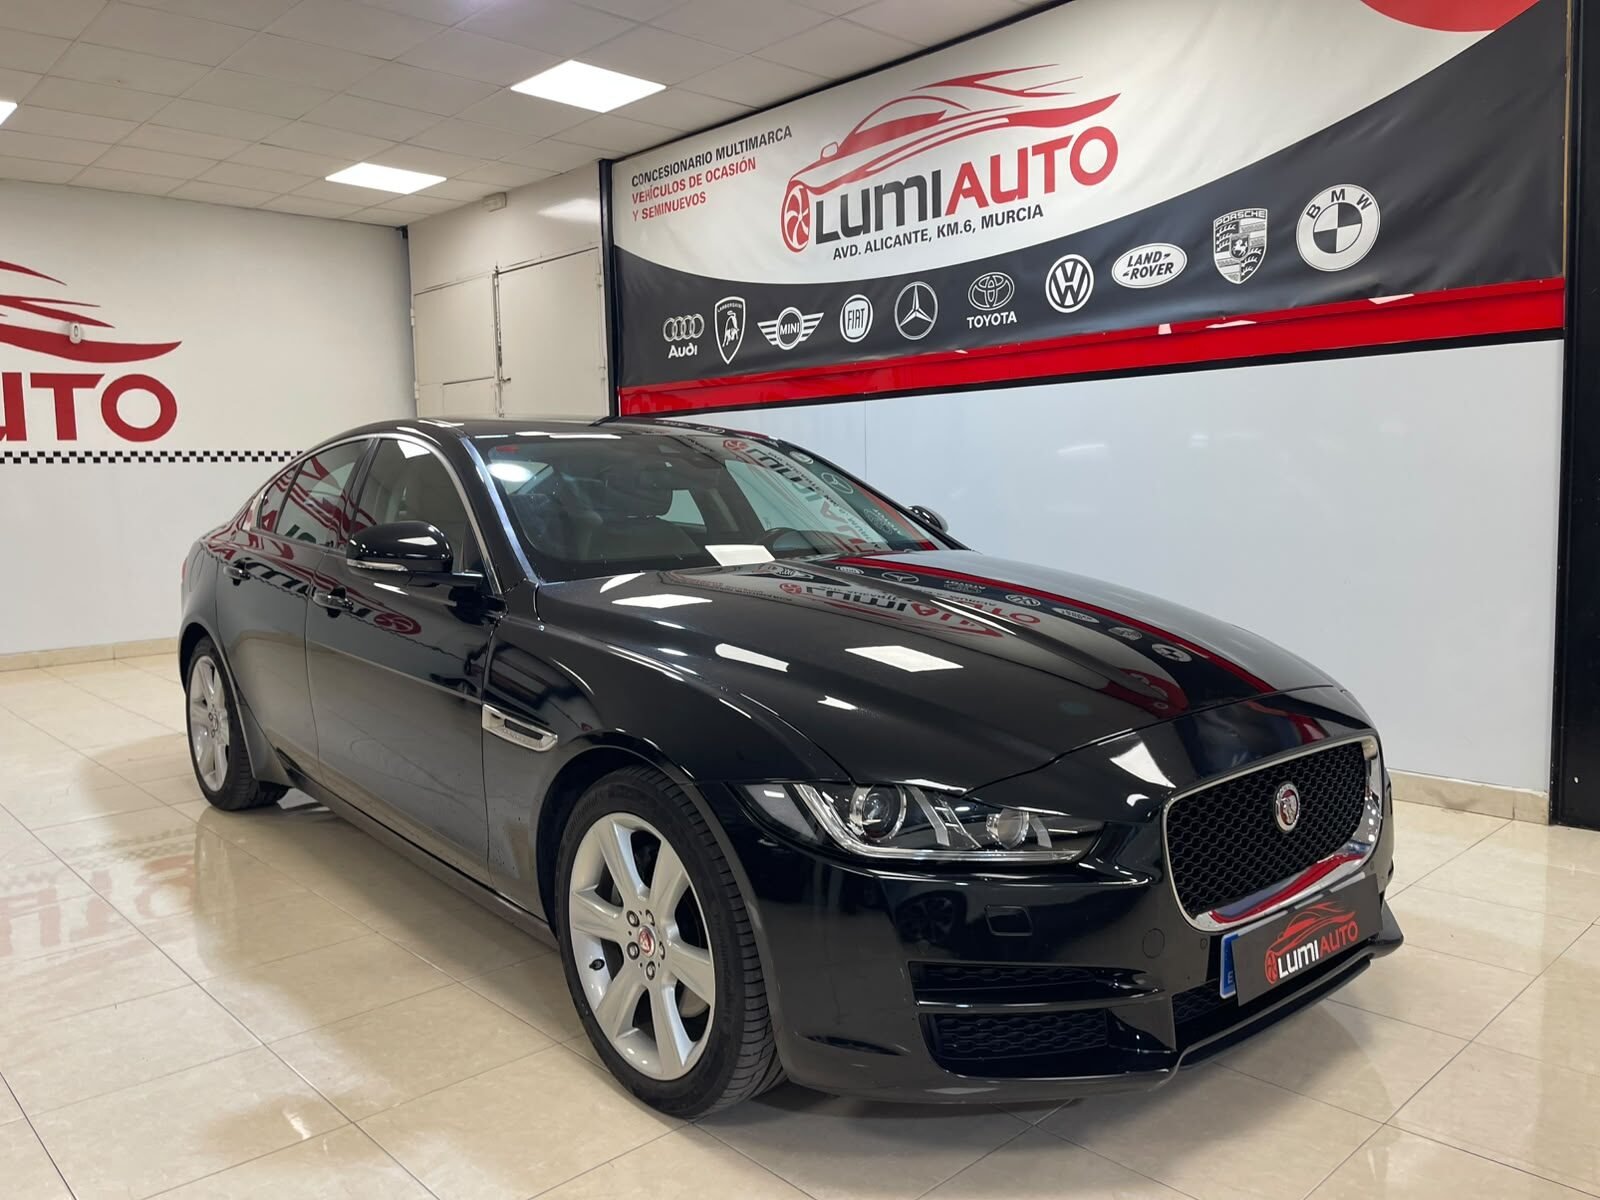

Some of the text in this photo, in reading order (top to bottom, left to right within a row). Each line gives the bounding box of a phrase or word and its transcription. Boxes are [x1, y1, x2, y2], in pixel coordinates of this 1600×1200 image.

[632, 125, 792, 187] CONCESIONARIO MULTIMARCA
[632, 156, 756, 204] VEHÍCULOS DE OCASIÓN
[632, 191, 706, 222] Y SEMINUEVOS
[1306, 188, 1373, 220] BMW
[1215, 209, 1266, 228] PORSCHE
[833, 204, 1044, 260] AVD. ALICANTE, KM.6, MURCIA
[779, 322, 800, 335] MINI
[847, 308, 865, 330] FIAT
[966, 311, 1017, 329] TOYOTA
[668, 342, 698, 359] Audi
